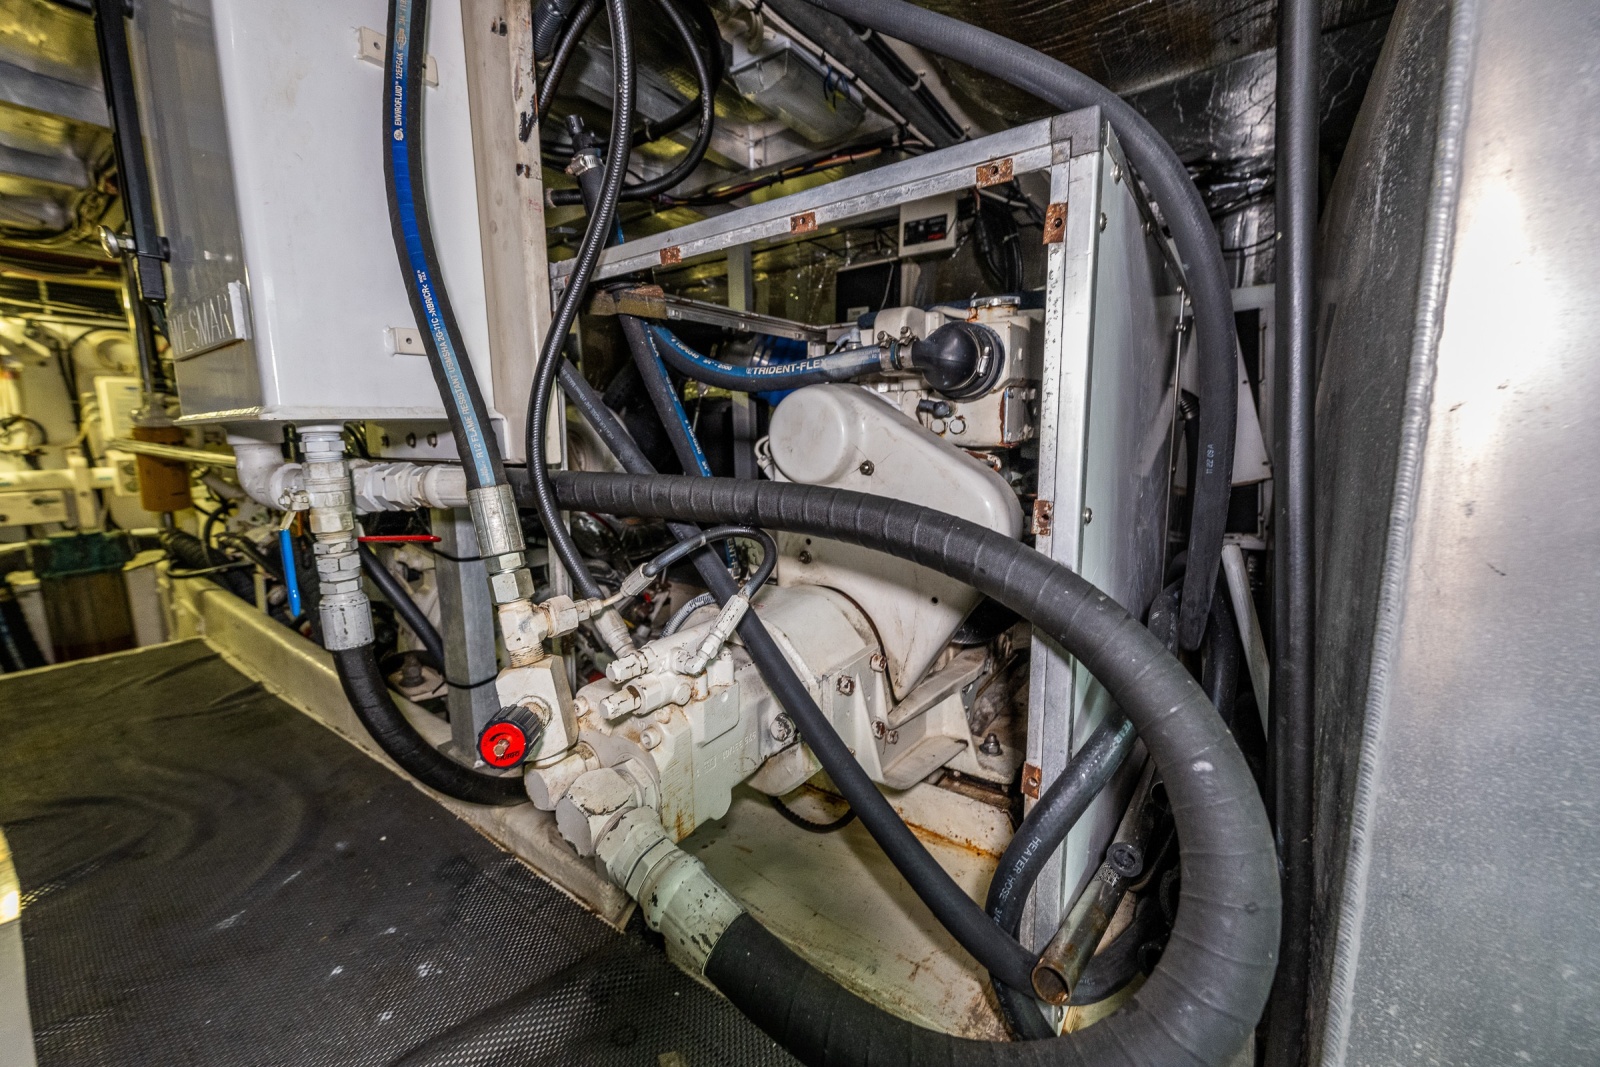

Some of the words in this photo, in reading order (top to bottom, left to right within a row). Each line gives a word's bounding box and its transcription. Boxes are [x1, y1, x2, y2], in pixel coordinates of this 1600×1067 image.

[168, 294, 232, 355] WESMAR
[450, 375, 470, 415] RESISTANT
[464, 416, 479, 443] FLAME
[1013, 836, 1042, 874] HEATER
[999, 875, 1016, 902] HOSE
